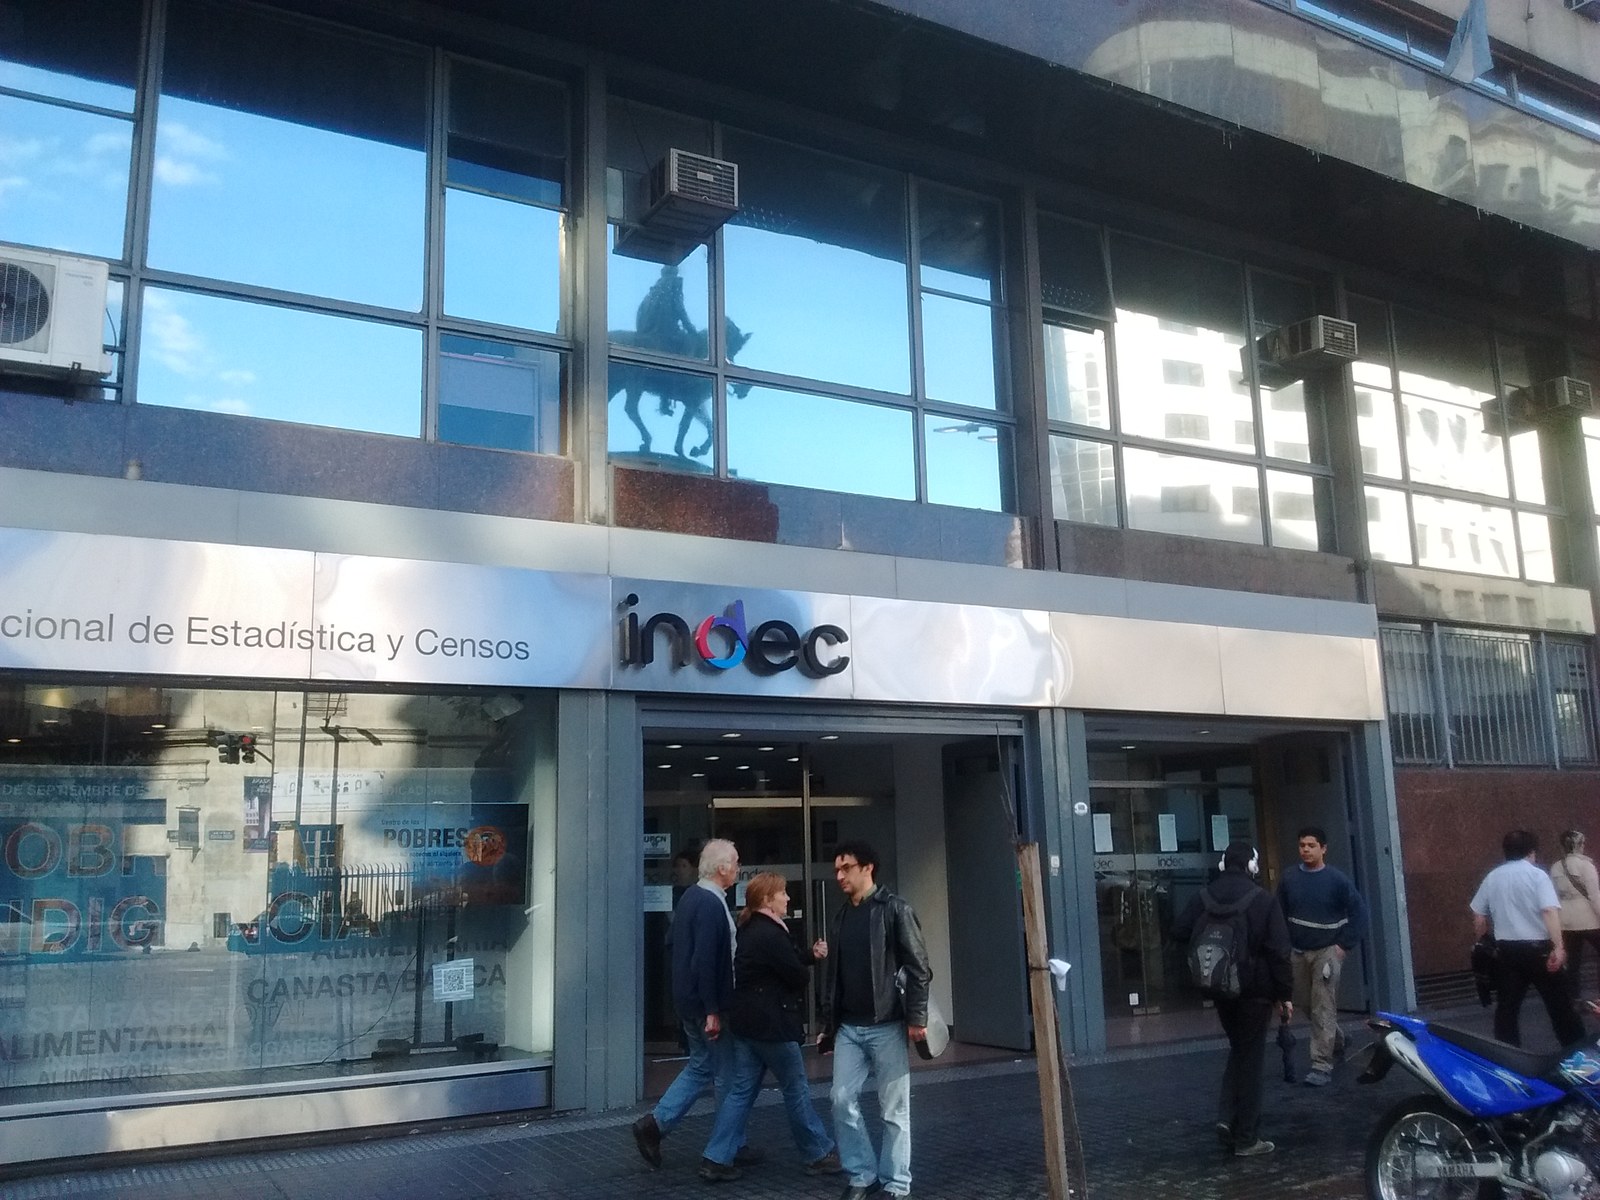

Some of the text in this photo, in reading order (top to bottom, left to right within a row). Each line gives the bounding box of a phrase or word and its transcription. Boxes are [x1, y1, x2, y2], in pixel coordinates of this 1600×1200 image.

[1, 608, 529, 661] cional de Estadística y Censos
[617, 593, 851, 679] indec
[383, 828, 469, 849] POBRES
[247, 972, 393, 1003] CANASTA
